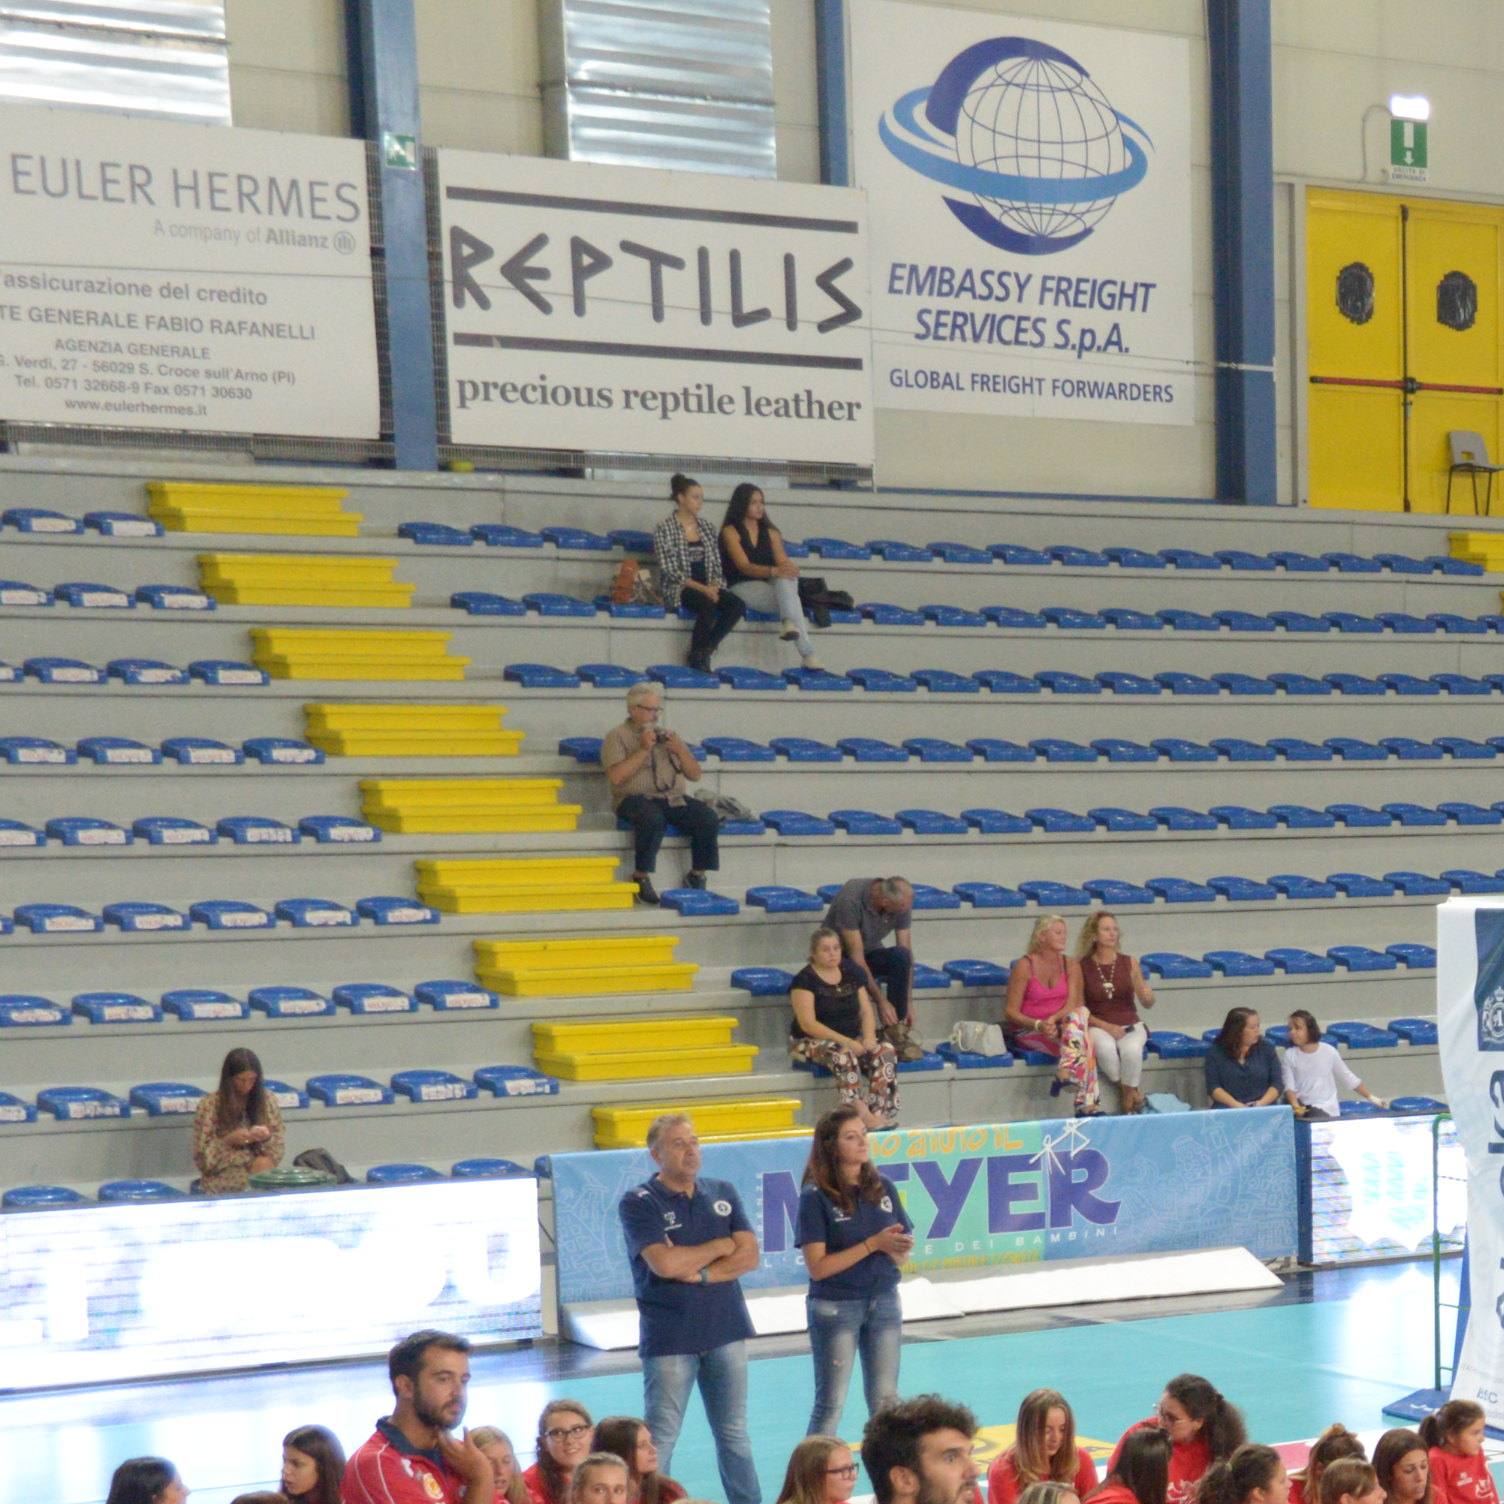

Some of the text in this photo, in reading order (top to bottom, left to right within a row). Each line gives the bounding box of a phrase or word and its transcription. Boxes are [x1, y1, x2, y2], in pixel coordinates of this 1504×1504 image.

[10, 153, 362, 223] EULER HERMES
[168, 223, 241, 246] company
[246, 226, 262, 244] of
[264, 228, 329, 249] Allianz
[159, 281, 190, 300] del
[197, 284, 268, 306] credito
[449, 225, 863, 334] REPTILIS
[887, 262, 1157, 313] EMBASSY FREIGHT
[28, 306, 139, 330] GENERALE
[145, 314, 204, 334] FABIO
[210, 319, 317, 341] RAFANELLI
[914, 308, 1131, 360] SERVICES S.p.A.
[54, 338, 212, 361] AGENZIA GENERALE
[14, 355, 57, 372] Verdi,
[61, 358, 79, 371] 27
[92, 360, 135, 375] 56029
[139, 363, 153, 376] S.
[157, 364, 201, 379] Croce
[204, 367, 268, 383] sull'Arno
[271, 370, 297, 386] (PI)
[14, 374, 253, 400] Tel. 0571 32668-9 Fax 0571 30630
[889, 368, 1175, 404] GLOBAL FREIGHT FORWARDERS
[64, 398, 208, 417] www.eulerhermes.it
[456, 373, 862, 422] precious reptile leather
[954, 1227, 1118, 1252] DEI BAMBINI
